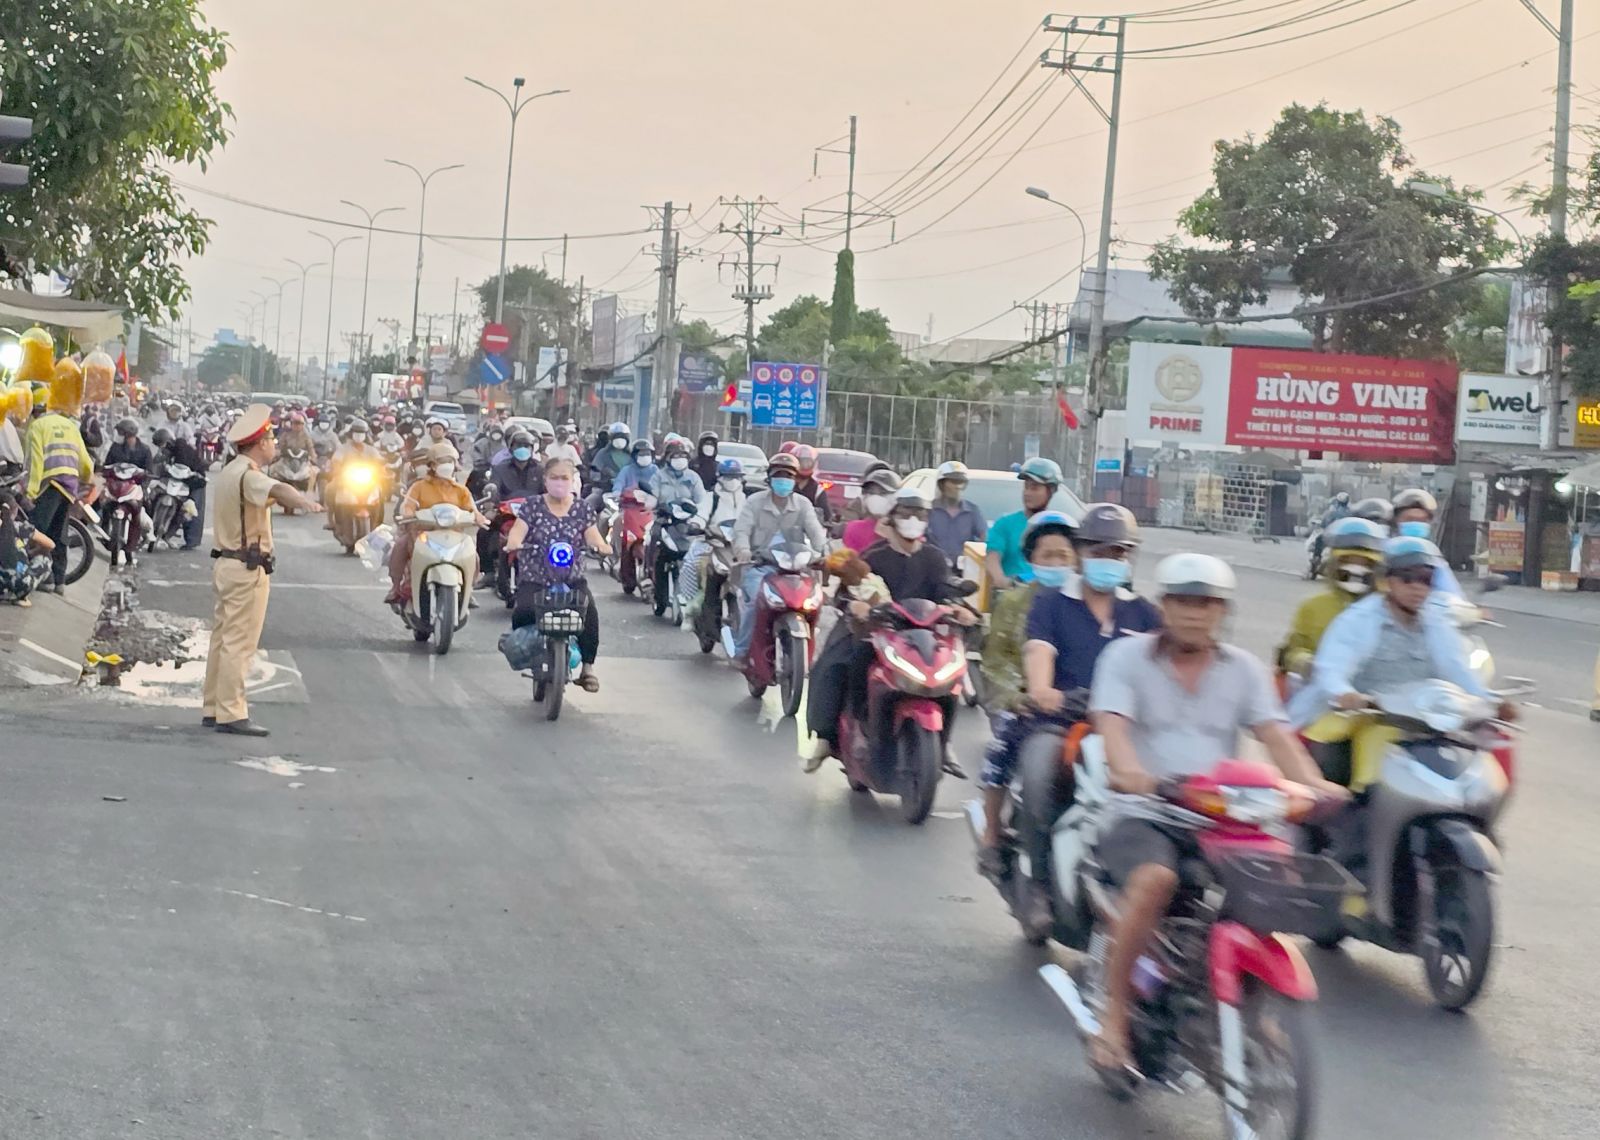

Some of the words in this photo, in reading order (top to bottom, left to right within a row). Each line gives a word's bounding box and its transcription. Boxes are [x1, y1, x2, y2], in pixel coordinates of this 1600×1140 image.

[1256, 372, 1339, 405] HÙNG
[1352, 382, 1428, 411] VINH
[1149, 415, 1203, 433] PRIME
